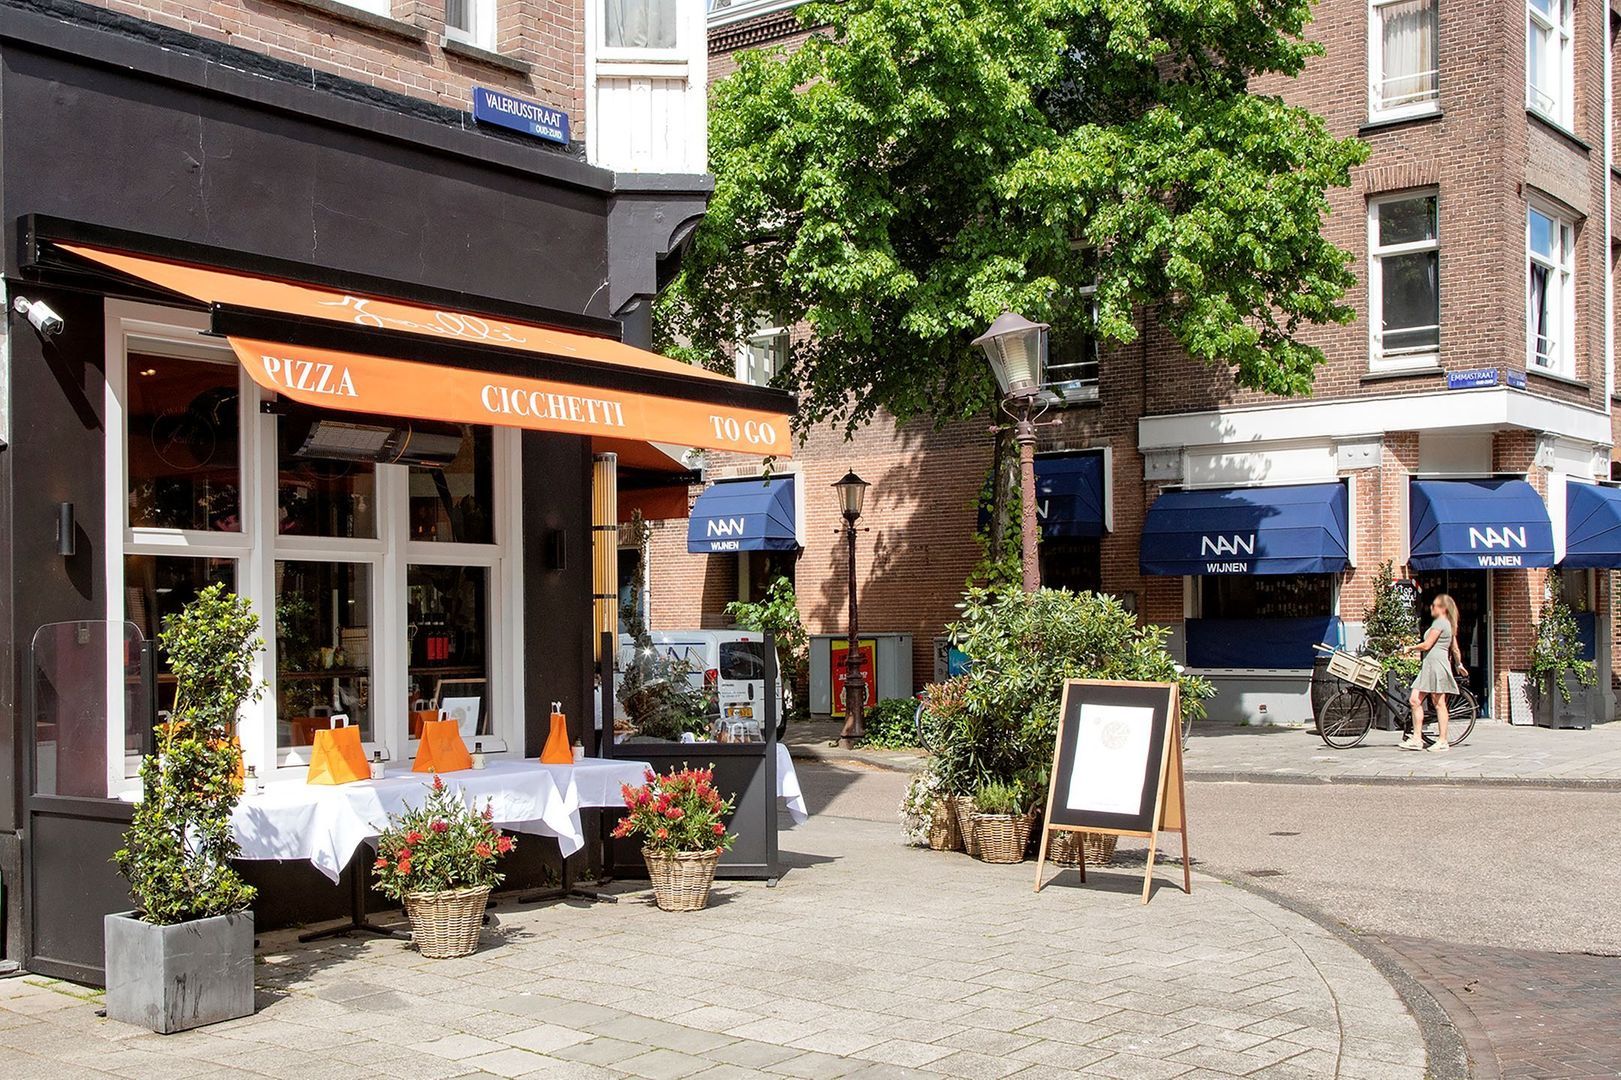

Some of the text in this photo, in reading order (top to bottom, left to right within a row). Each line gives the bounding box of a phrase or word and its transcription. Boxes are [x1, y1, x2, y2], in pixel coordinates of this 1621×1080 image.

[485, 92, 561, 127] VALERIUSSTRAAT
[535, 124, 562, 139] OUD-ZUID
[261, 355, 359, 397] PIZZA
[1451, 371, 1494, 381] EMMASTRAAT
[481, 384, 626, 428] CICCHETTI
[709, 415, 776, 446] TO GO
[707, 518, 744, 536] NAN
[711, 541, 739, 550] WIJNEN
[1201, 534, 1255, 556] NAN
[1469, 527, 1526, 549] NAN
[1206, 562, 1247, 573] WIJNEN
[1478, 555, 1522, 567] WIJNEN
